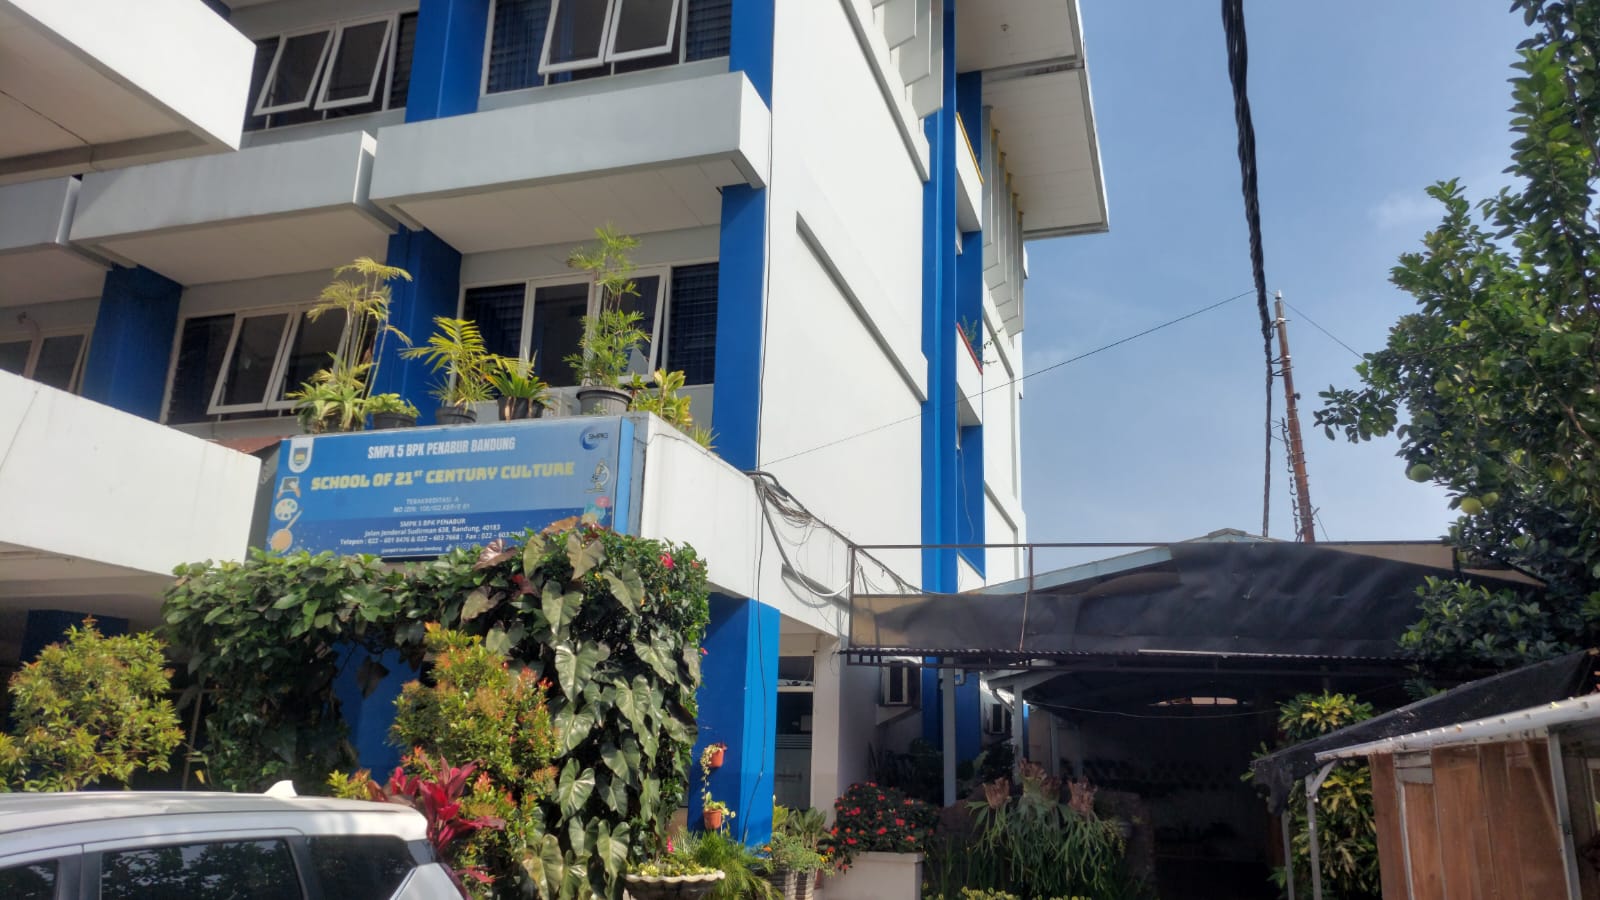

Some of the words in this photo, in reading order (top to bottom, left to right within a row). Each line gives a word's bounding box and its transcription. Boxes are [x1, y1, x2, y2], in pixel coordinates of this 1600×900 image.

[368, 446, 395, 459] SMPK
[397, 445, 404, 458] 5
[406, 443, 425, 457] BPK
[426, 440, 469, 455] PENABUR
[471, 437, 516, 452] BANDUNG
[311, 474, 370, 491] SCHOOL
[373, 472, 394, 487] OF
[425, 465, 498, 484] CENTURY
[501, 462, 575, 480] CULTURE
[380, 528, 406, 536] Jenderal
